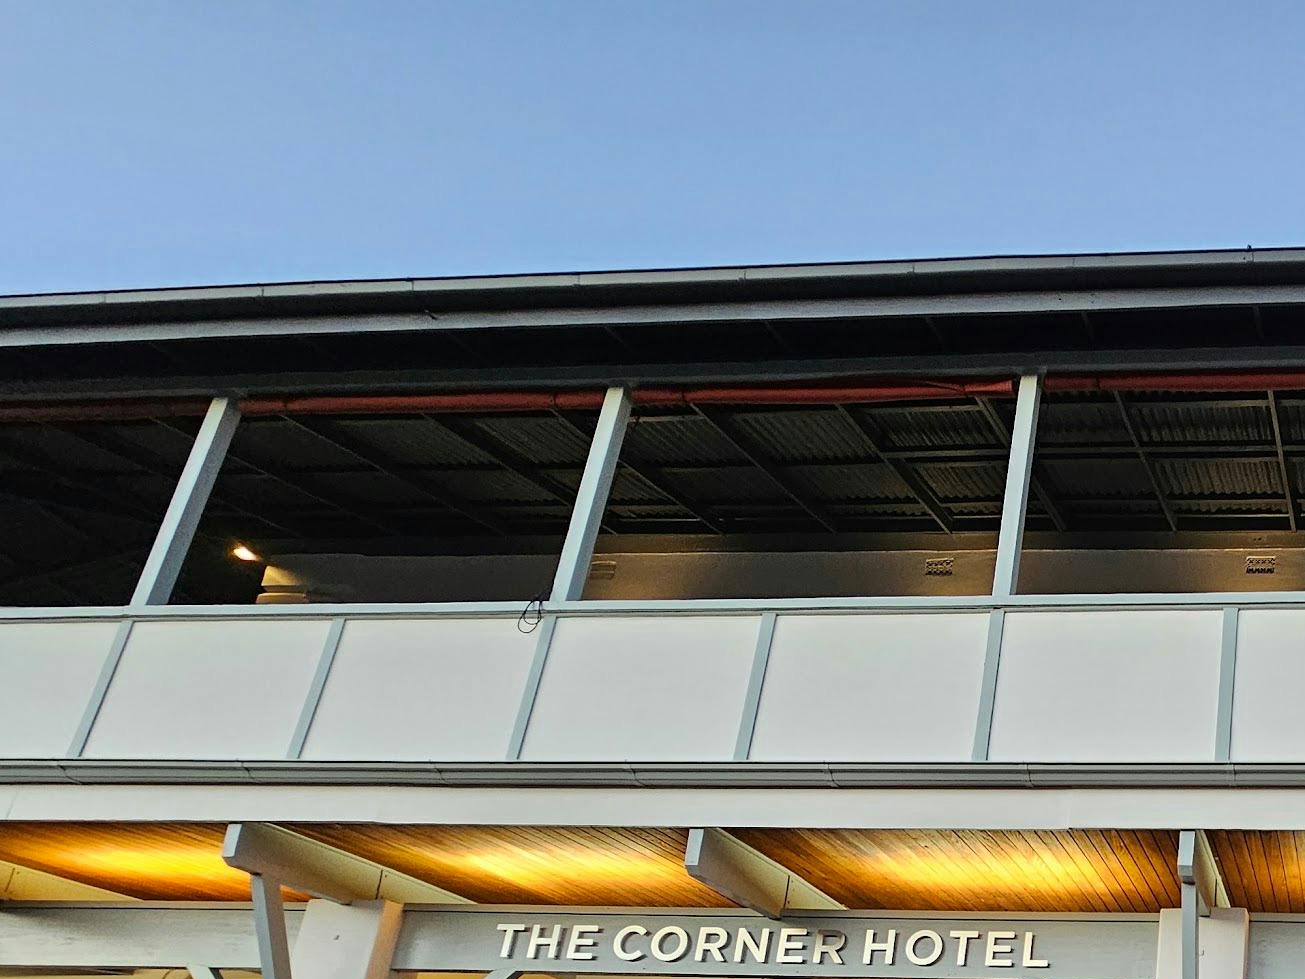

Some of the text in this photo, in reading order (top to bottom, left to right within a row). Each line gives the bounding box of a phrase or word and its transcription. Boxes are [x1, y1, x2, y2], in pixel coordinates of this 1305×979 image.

[496, 923, 1051, 970] THE CORNER HOTEL
